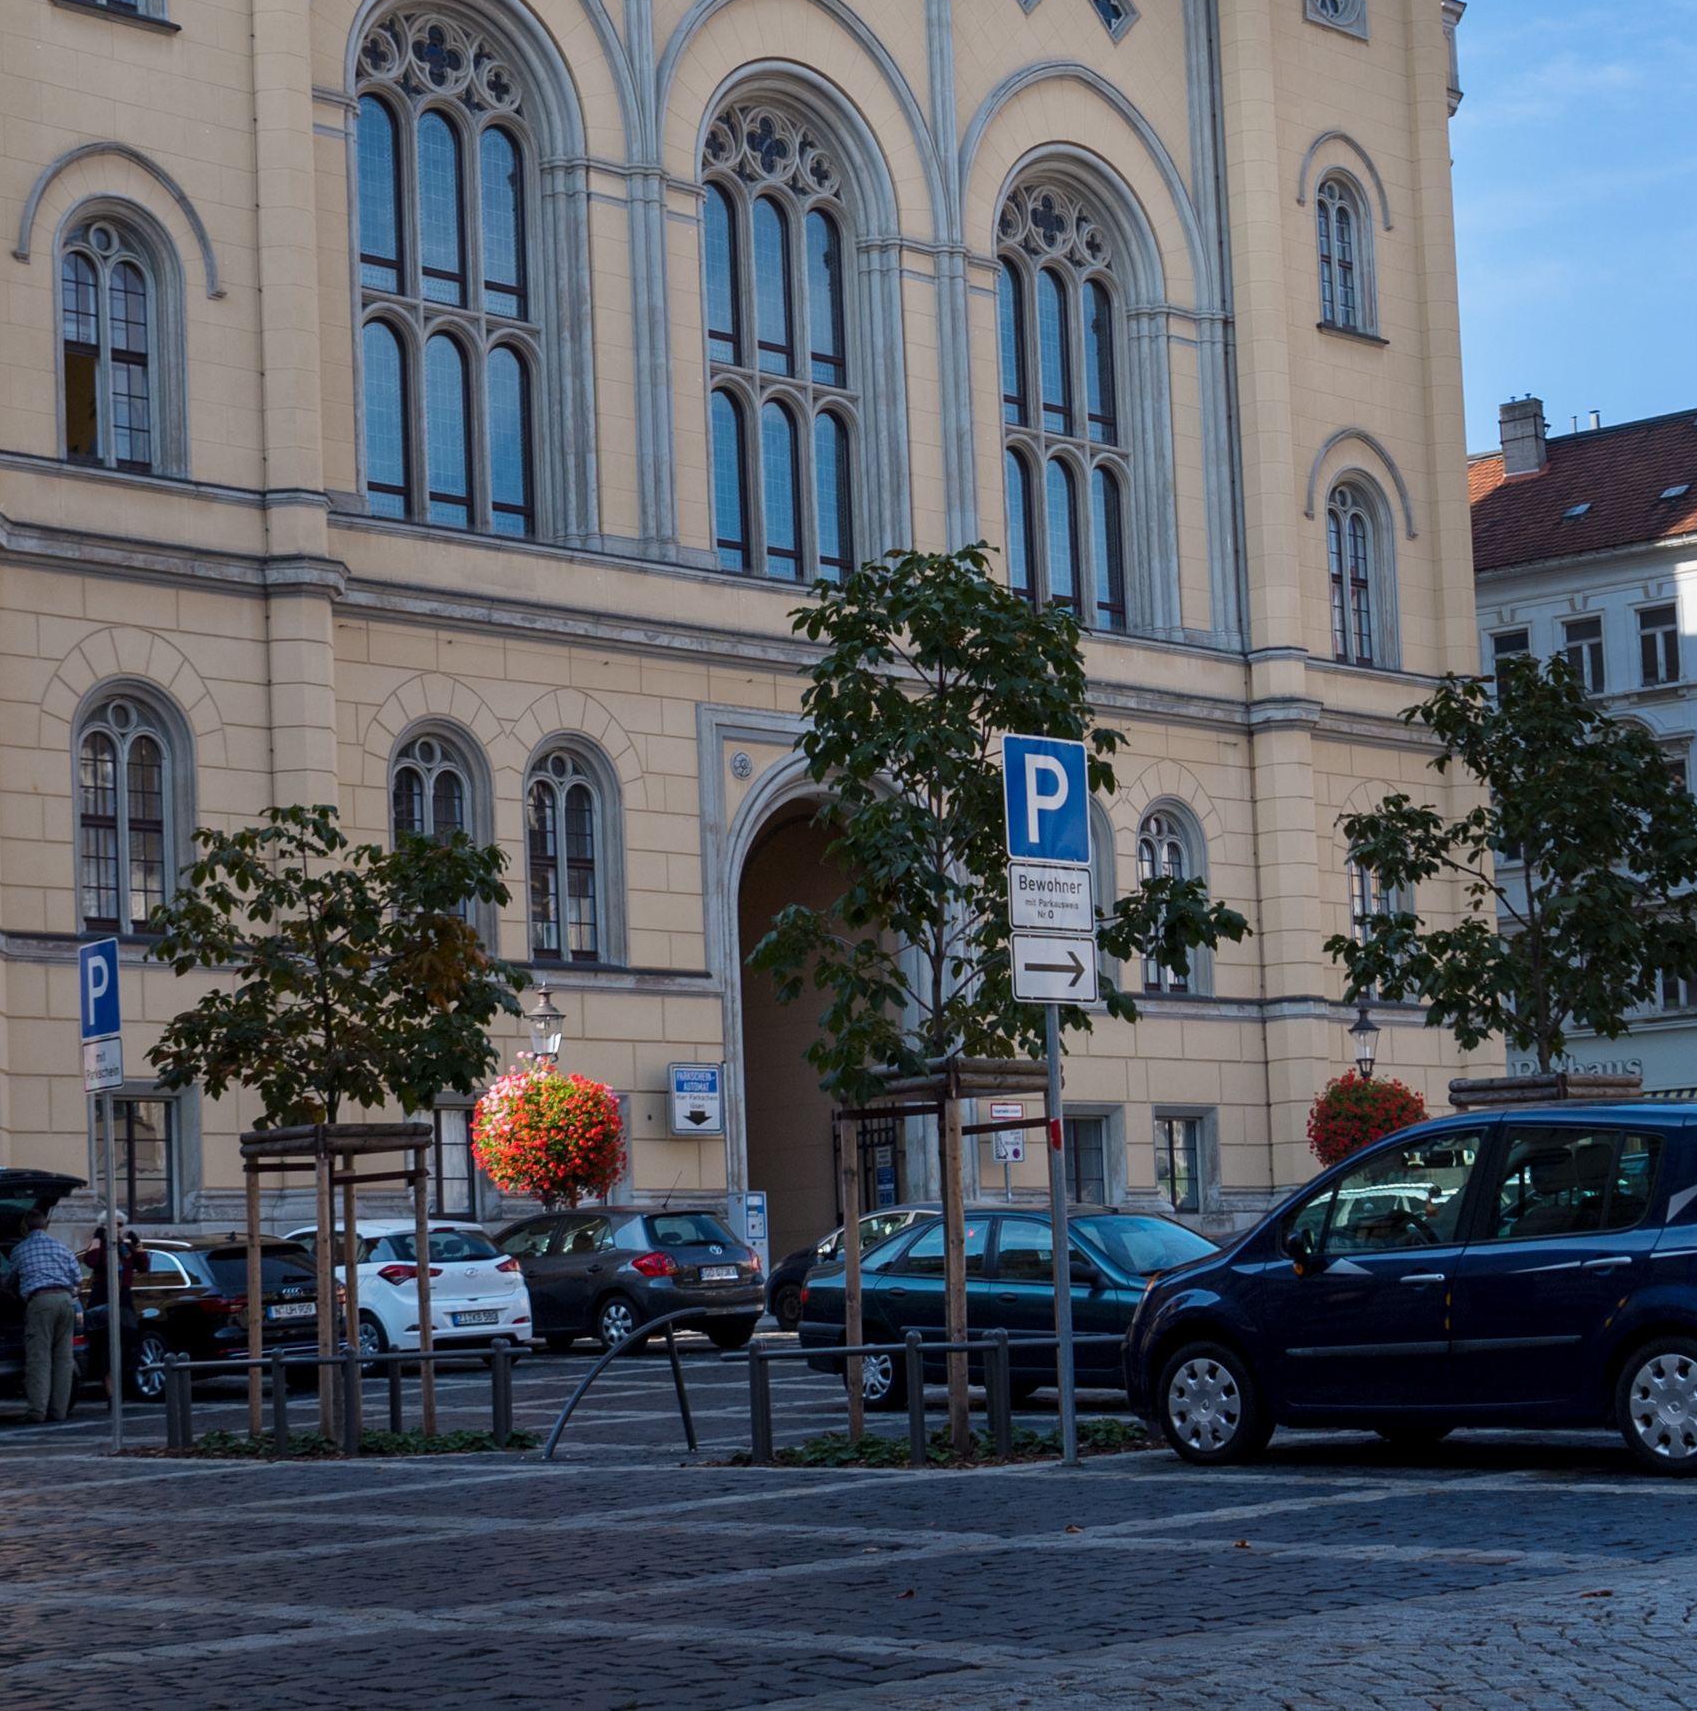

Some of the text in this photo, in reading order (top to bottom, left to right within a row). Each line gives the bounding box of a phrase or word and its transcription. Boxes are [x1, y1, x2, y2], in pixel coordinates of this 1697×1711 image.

[1024, 753, 1069, 843] P
[1019, 874, 1082, 894] Bewohner
[1025, 898, 1079, 910] mit Parkausweis
[1037, 909, 1047, 919] Nr.
[88, 955, 109, 1026] P
[96, 1050, 106, 1063] mit
[86, 1064, 120, 1082] Parkschein
[1513, 1056, 1643, 1076] Rthaus
[684, 1082, 709, 1091] AUTOMAT
